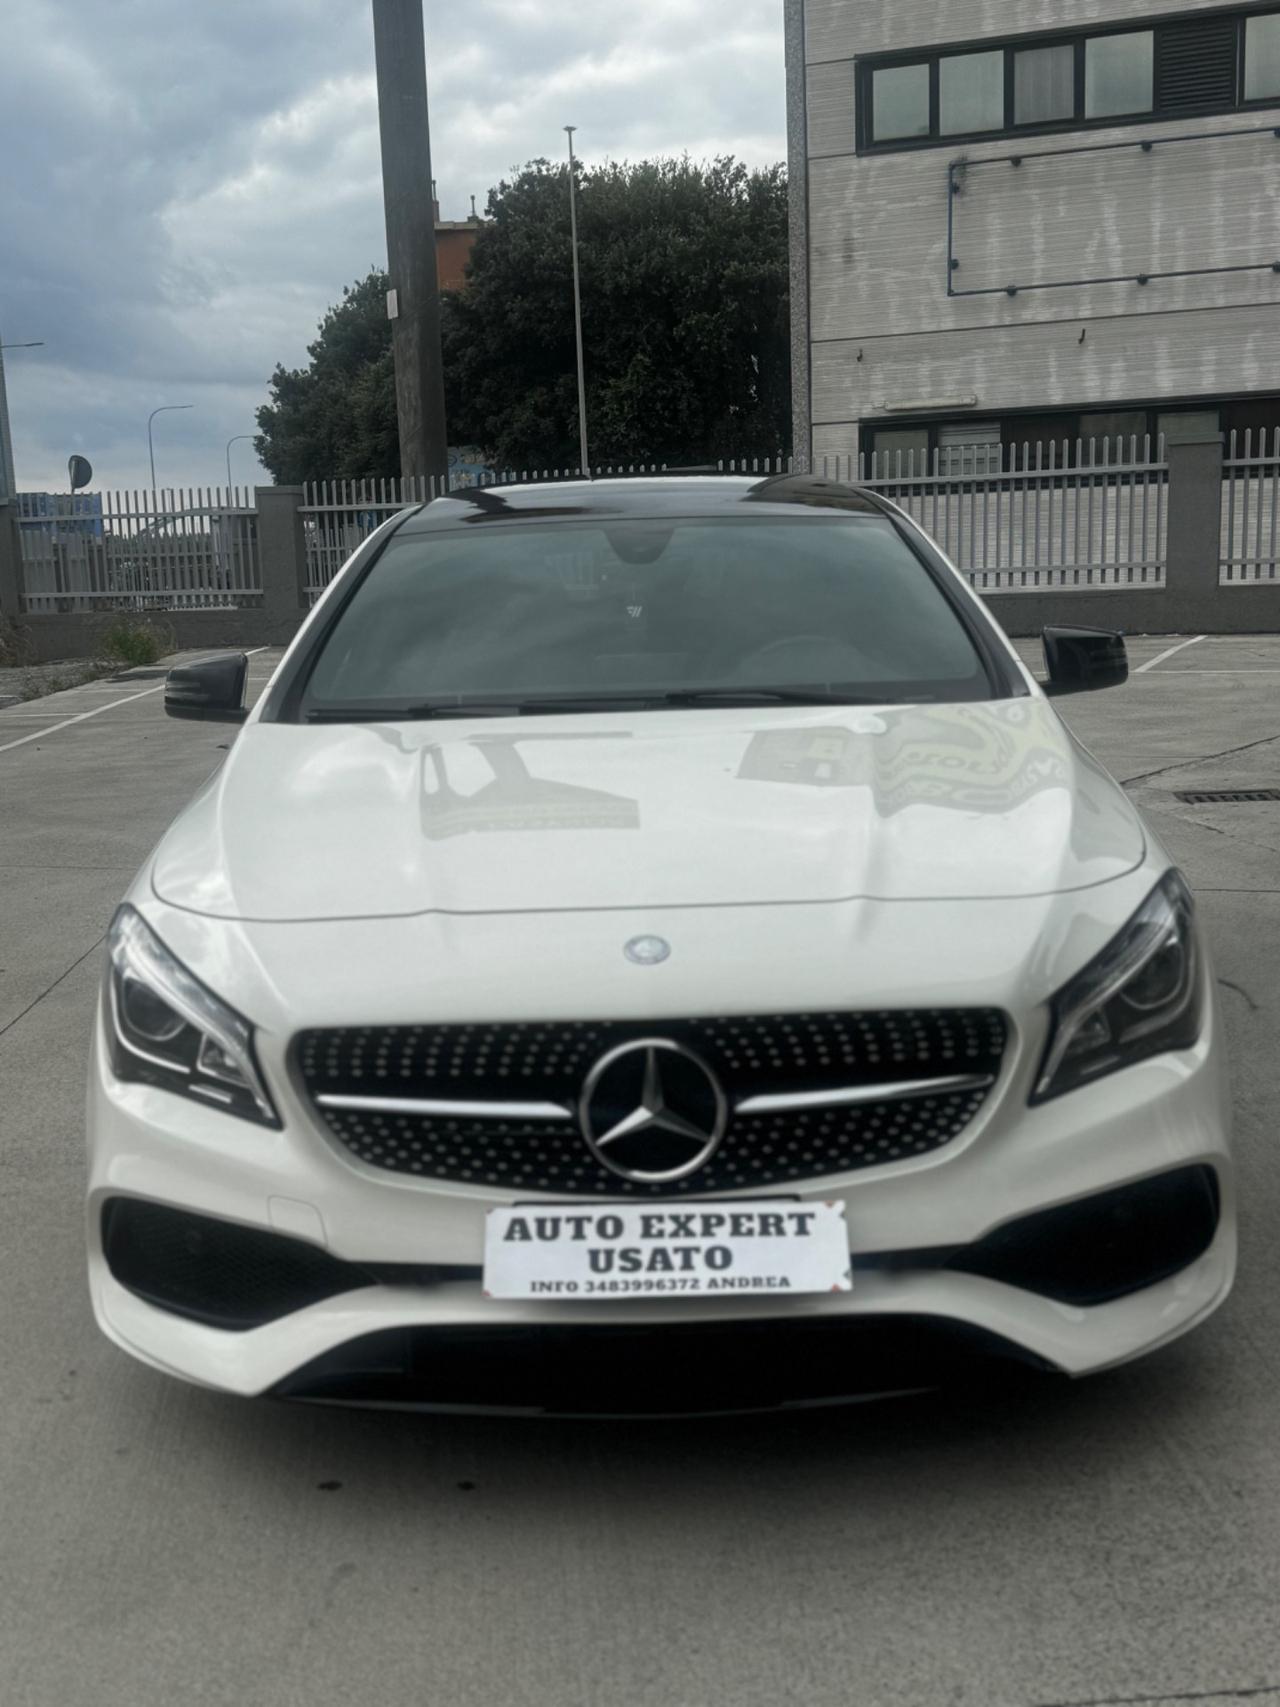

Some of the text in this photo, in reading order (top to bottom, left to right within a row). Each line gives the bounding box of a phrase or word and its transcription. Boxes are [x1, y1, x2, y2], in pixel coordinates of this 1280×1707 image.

[503, 1212, 815, 1241] AUTO EXPERT
[588, 1245, 733, 1273] USATO
[530, 1276, 792, 1294] INFO 3483996372 ANDREA
